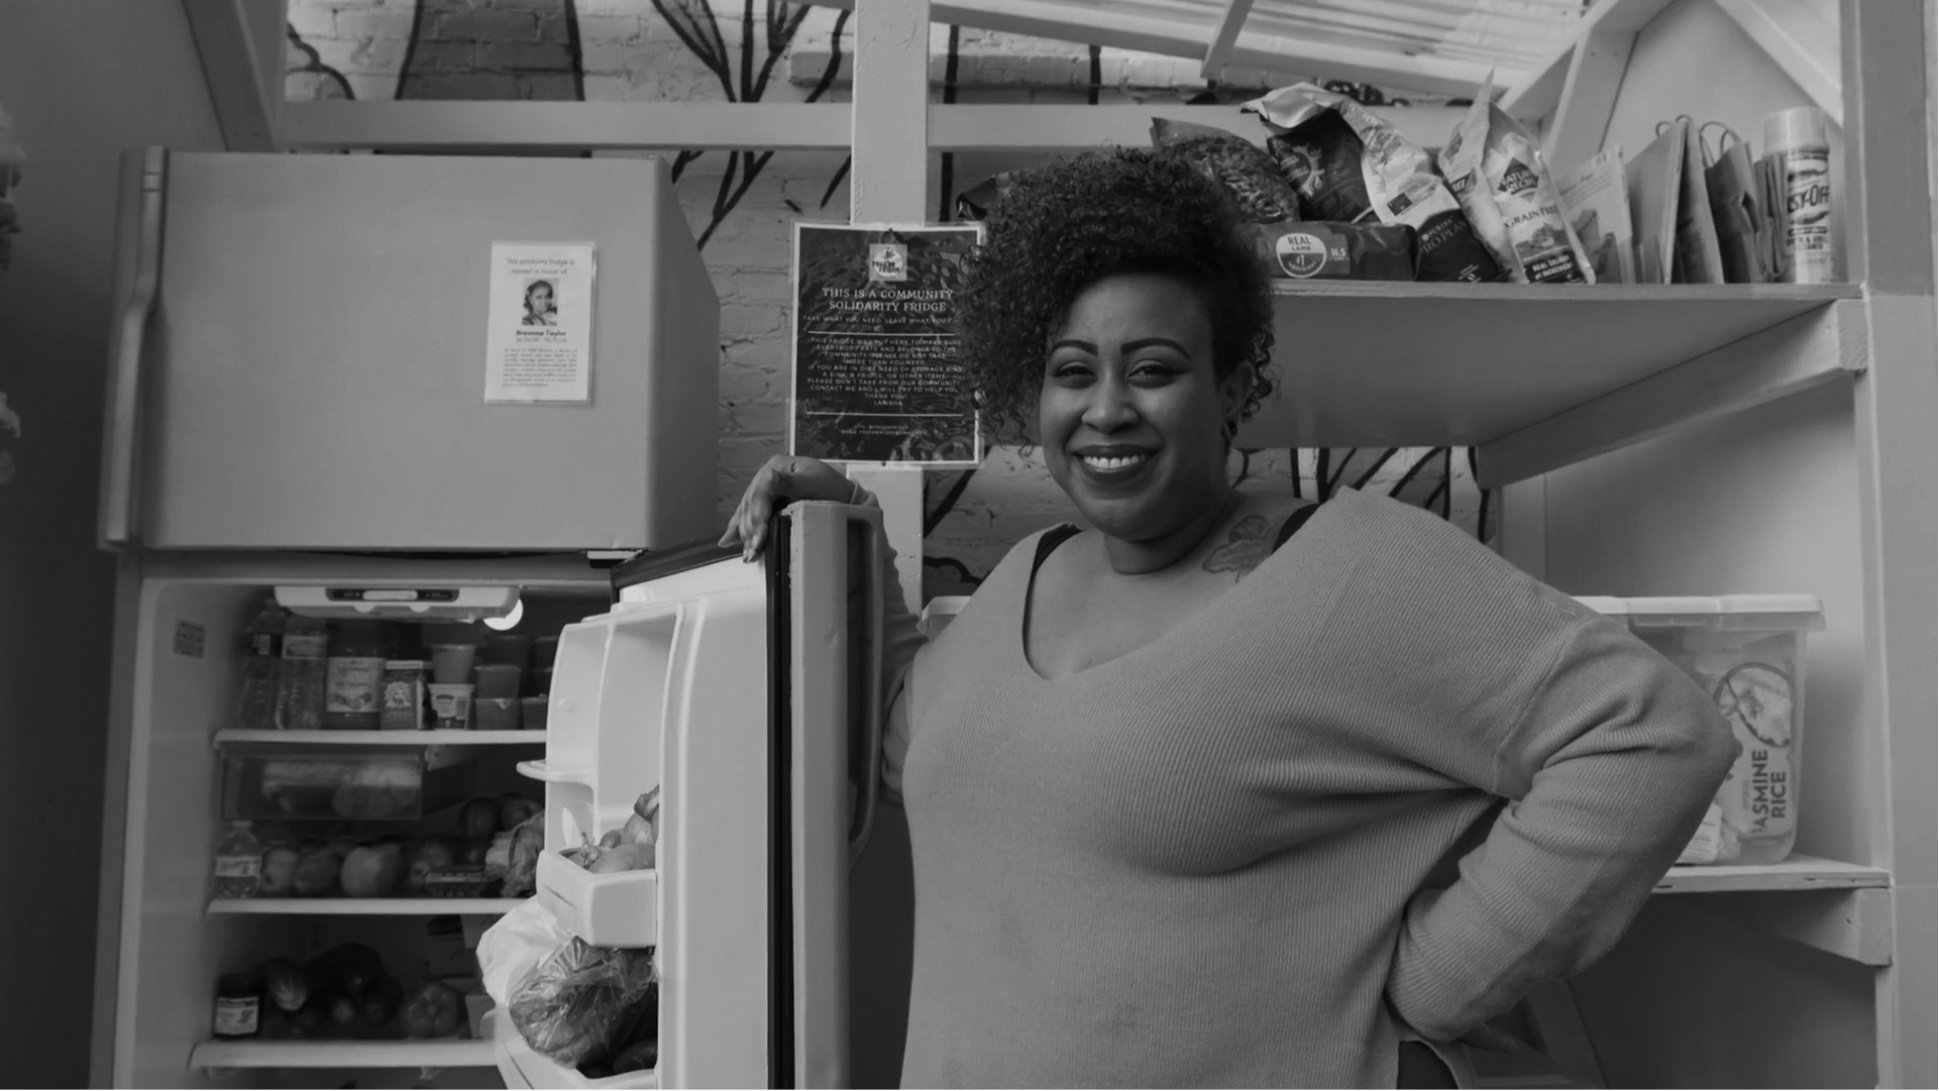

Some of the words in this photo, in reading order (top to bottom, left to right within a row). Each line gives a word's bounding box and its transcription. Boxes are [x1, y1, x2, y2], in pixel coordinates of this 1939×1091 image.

[1504, 211, 1540, 227] GRAIN
[1286, 235, 1312, 246] REAL
[822, 287, 850, 298] THIS
[854, 288, 865, 299] IS
[869, 289, 877, 299] A
[880, 289, 954, 300] COMMUNITY
[829, 301, 899, 312] SOLIDARITY
[904, 302, 946, 312] FRIDGE
[546, 329, 567, 337] Taylor
[807, 377, 833, 385] PLEASE
[1770, 771, 1786, 818] RICE
